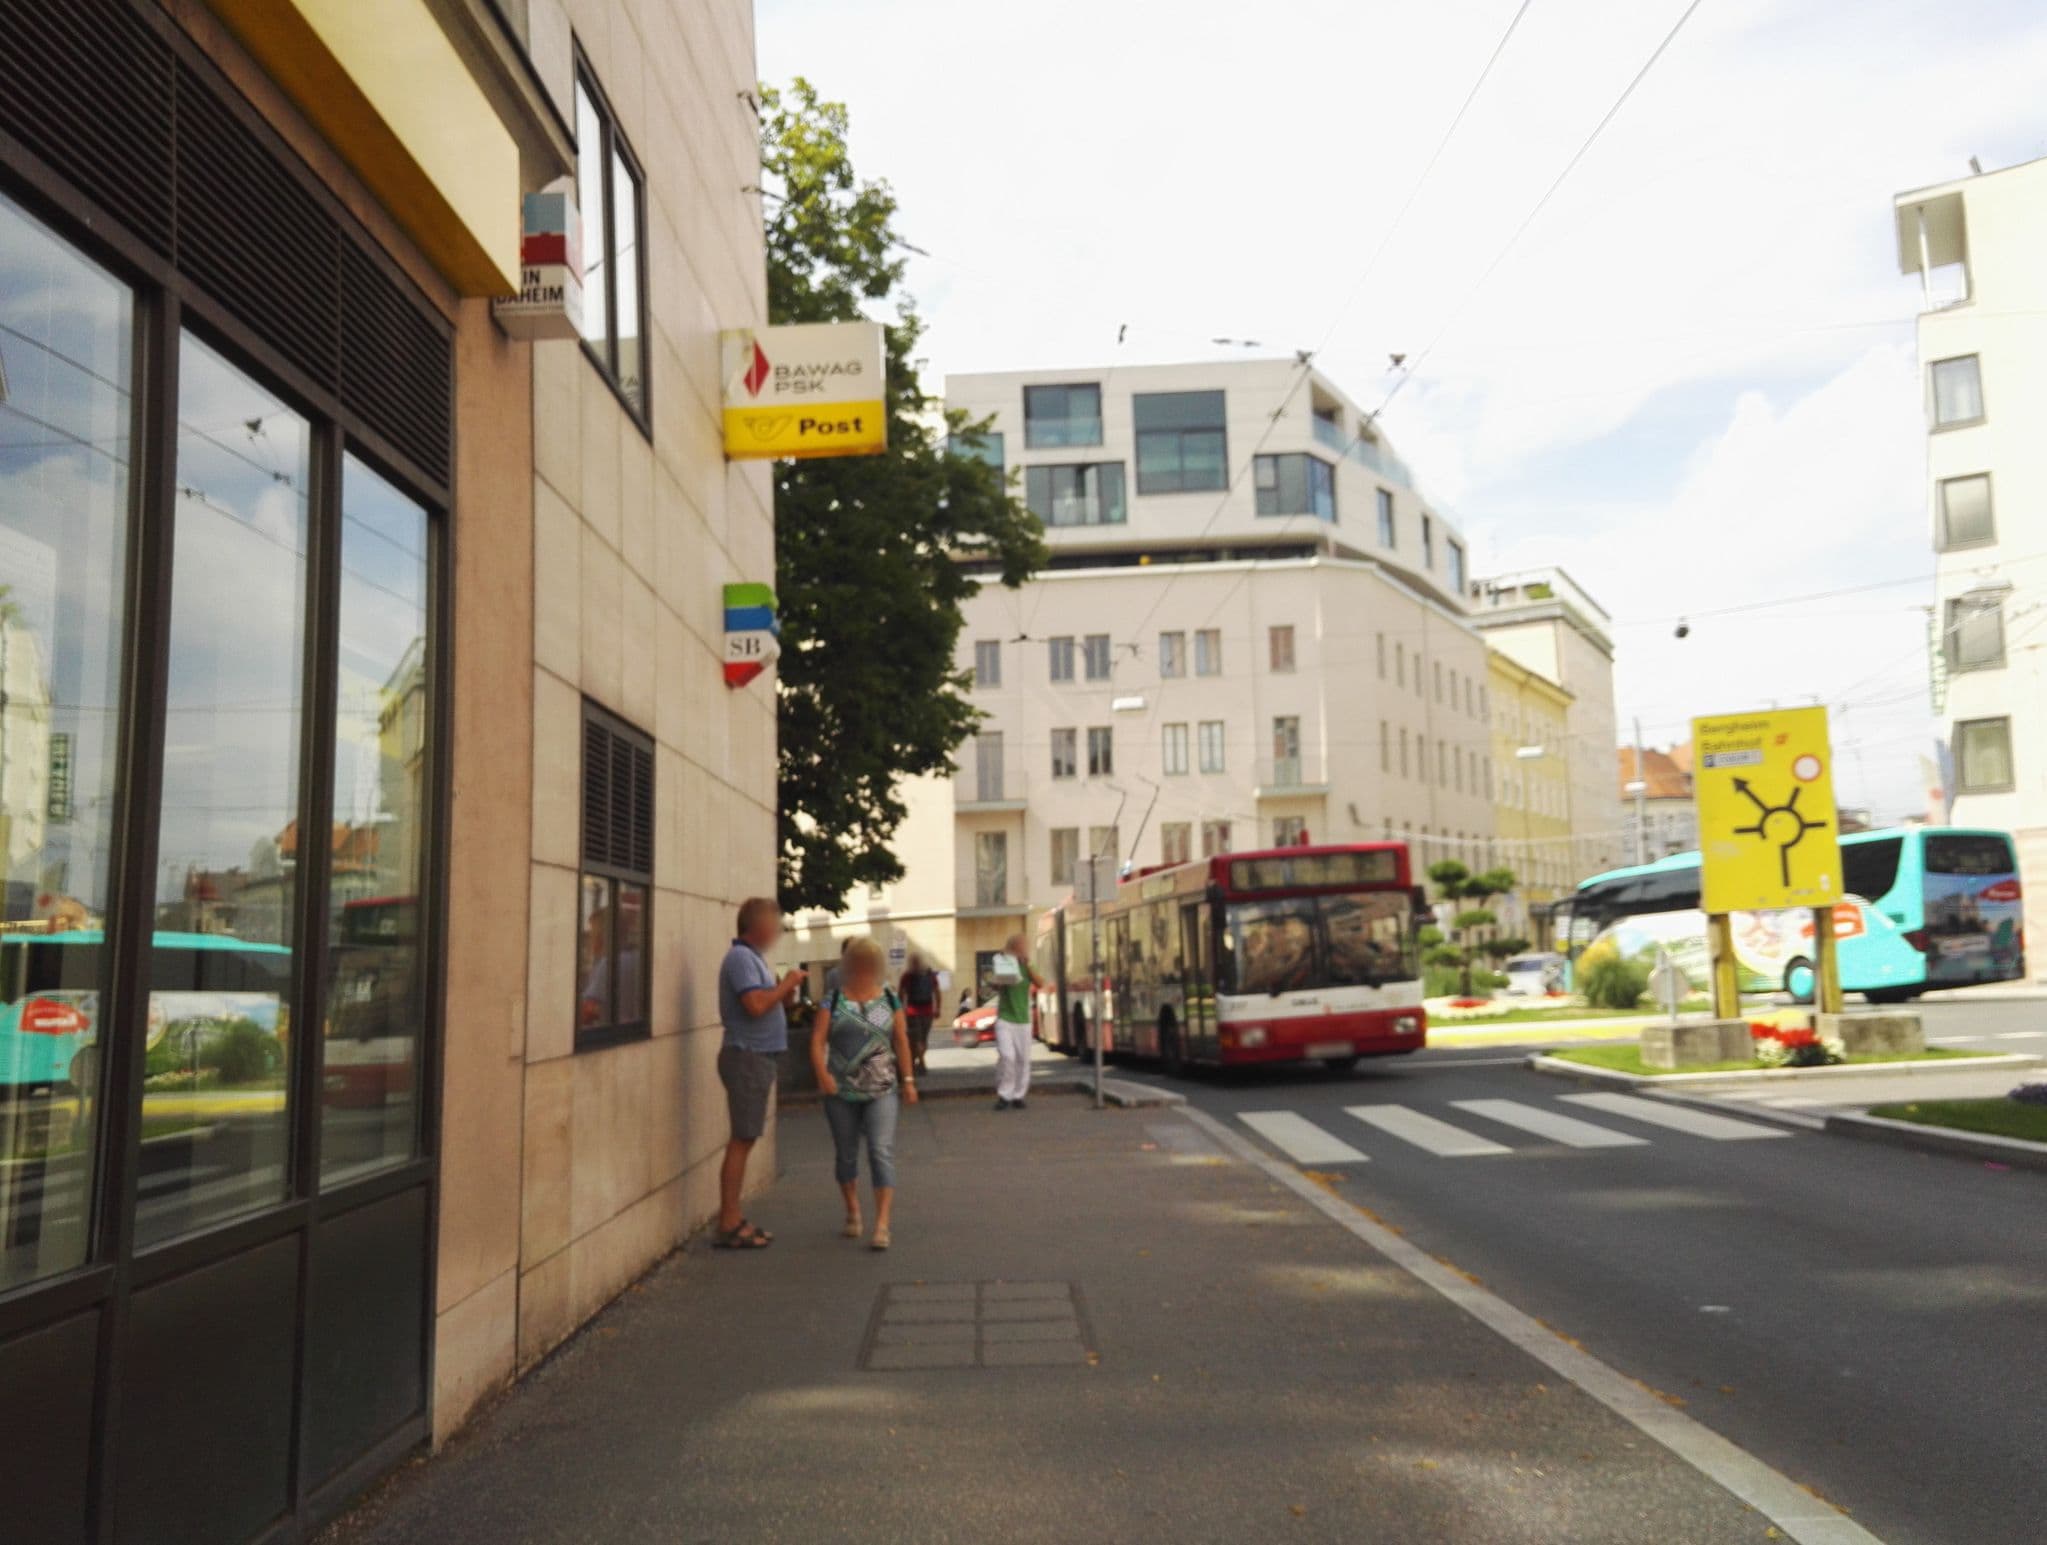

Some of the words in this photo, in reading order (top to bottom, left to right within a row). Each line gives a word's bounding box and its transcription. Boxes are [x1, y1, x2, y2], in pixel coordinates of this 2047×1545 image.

[522, 269, 540, 285] IN
[775, 361, 863, 379] BAWAG
[775, 380, 825, 394] PSK
[800, 418, 863, 436] Post
[730, 638, 761, 656] SB
